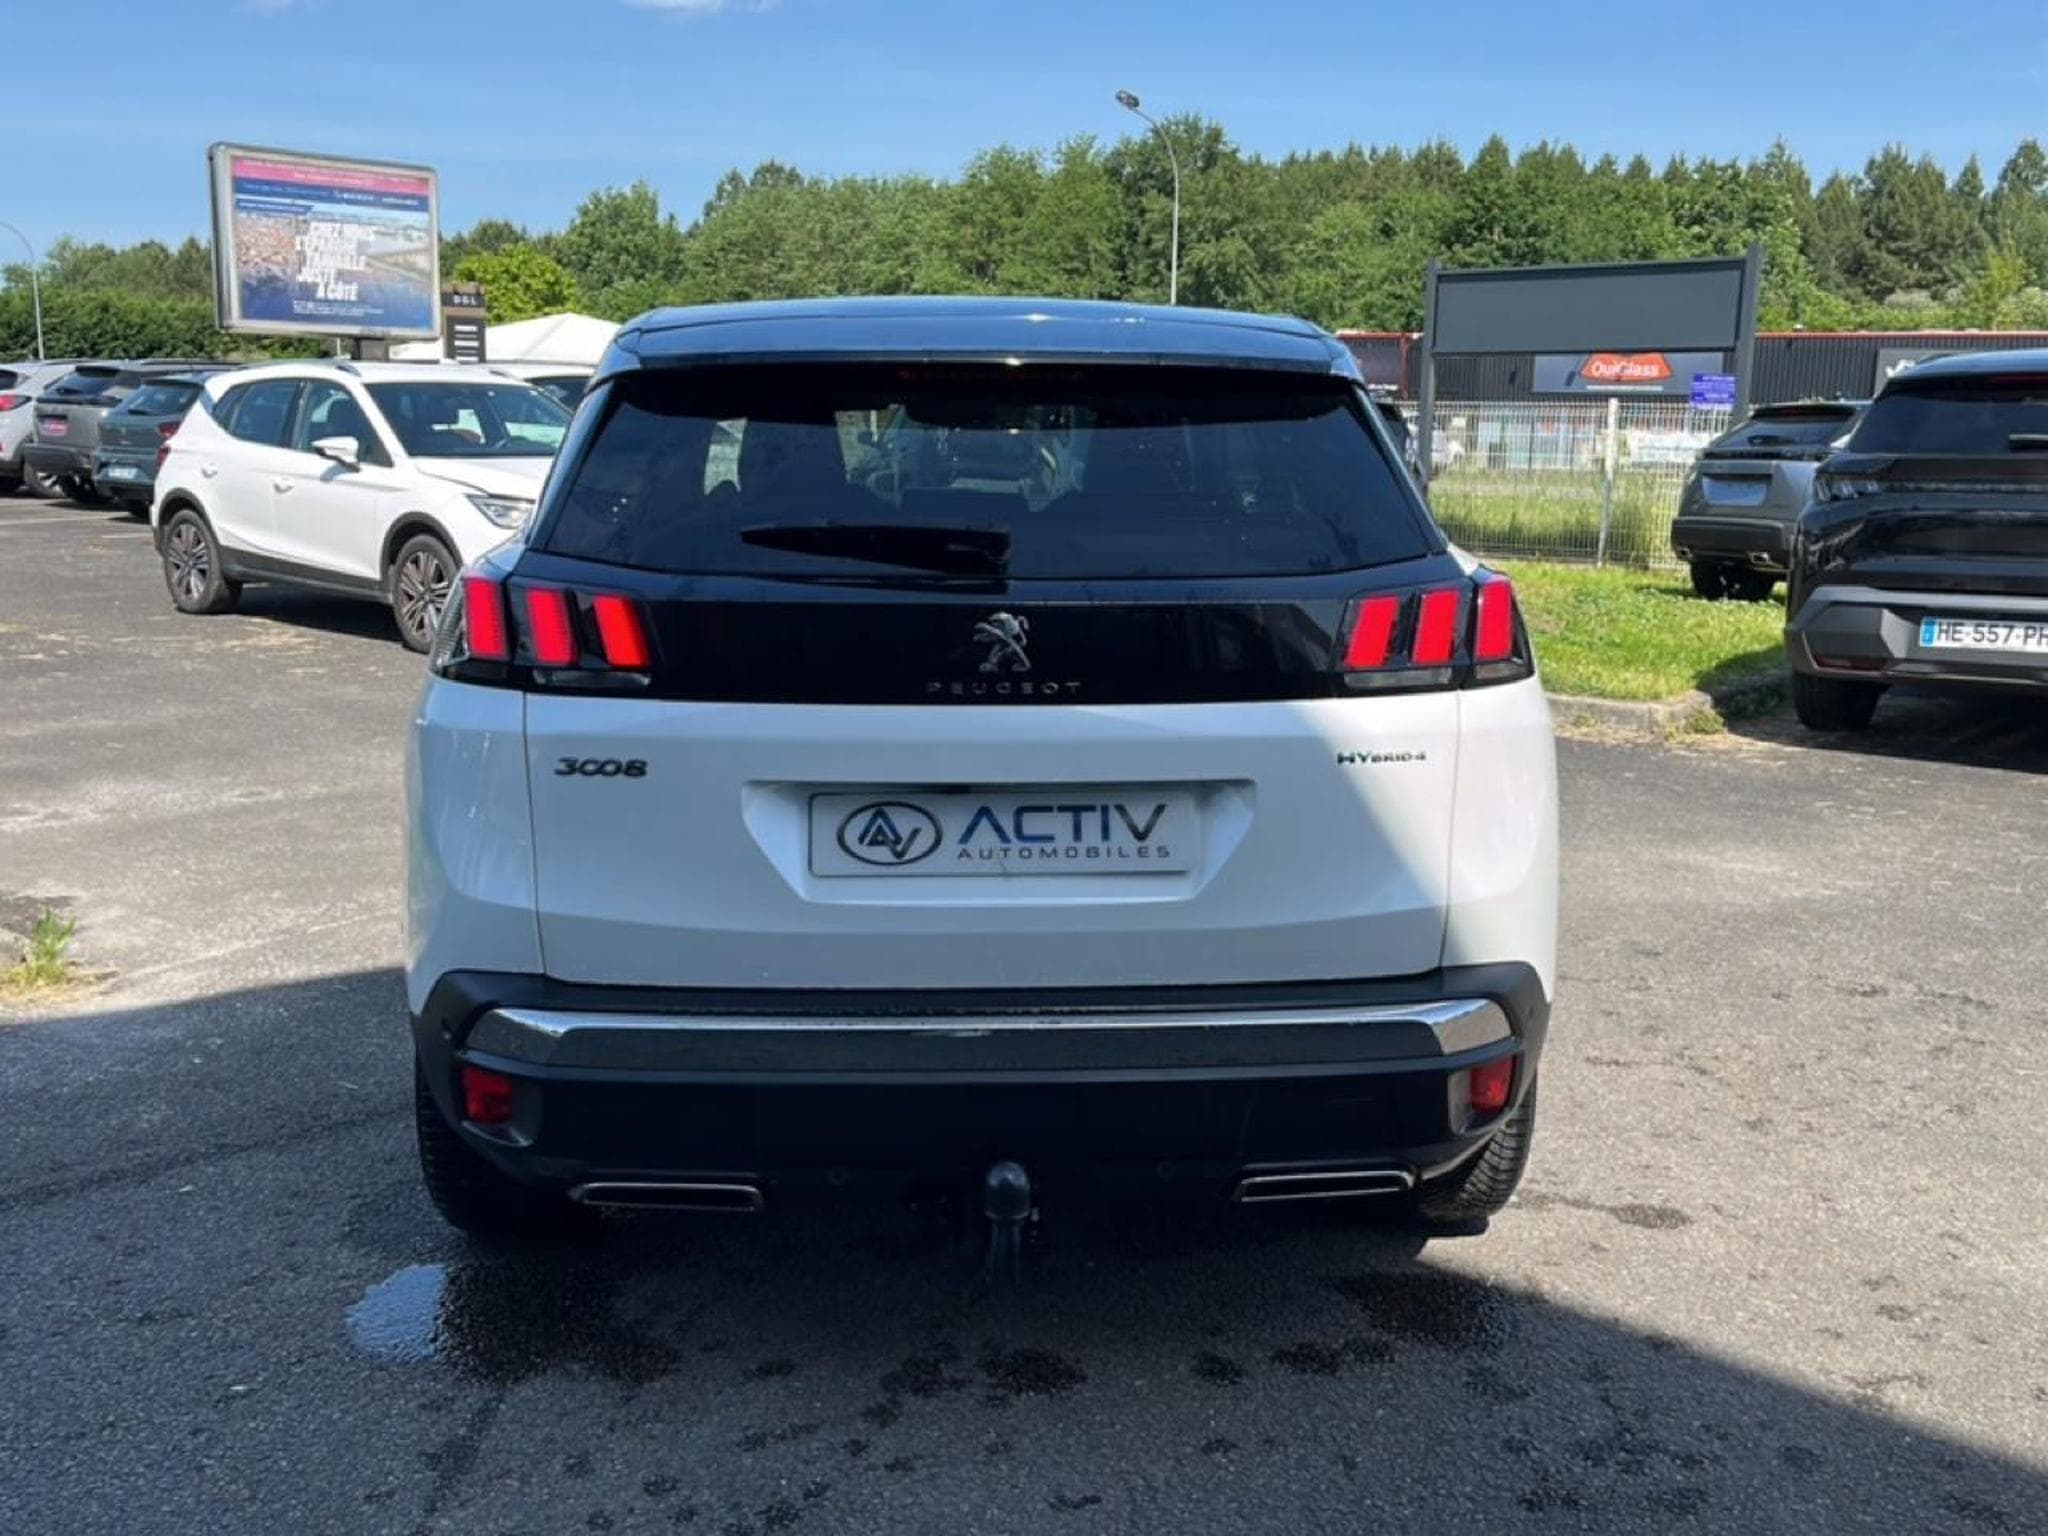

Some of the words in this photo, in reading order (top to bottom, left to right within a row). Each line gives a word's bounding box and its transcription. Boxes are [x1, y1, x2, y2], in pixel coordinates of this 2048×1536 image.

[928, 682, 1080, 694] PEUGEOT
[554, 757, 648, 777] 3008
[957, 804, 1167, 844] ACTIV
[957, 845, 1170, 860] AUTOMOBILES
